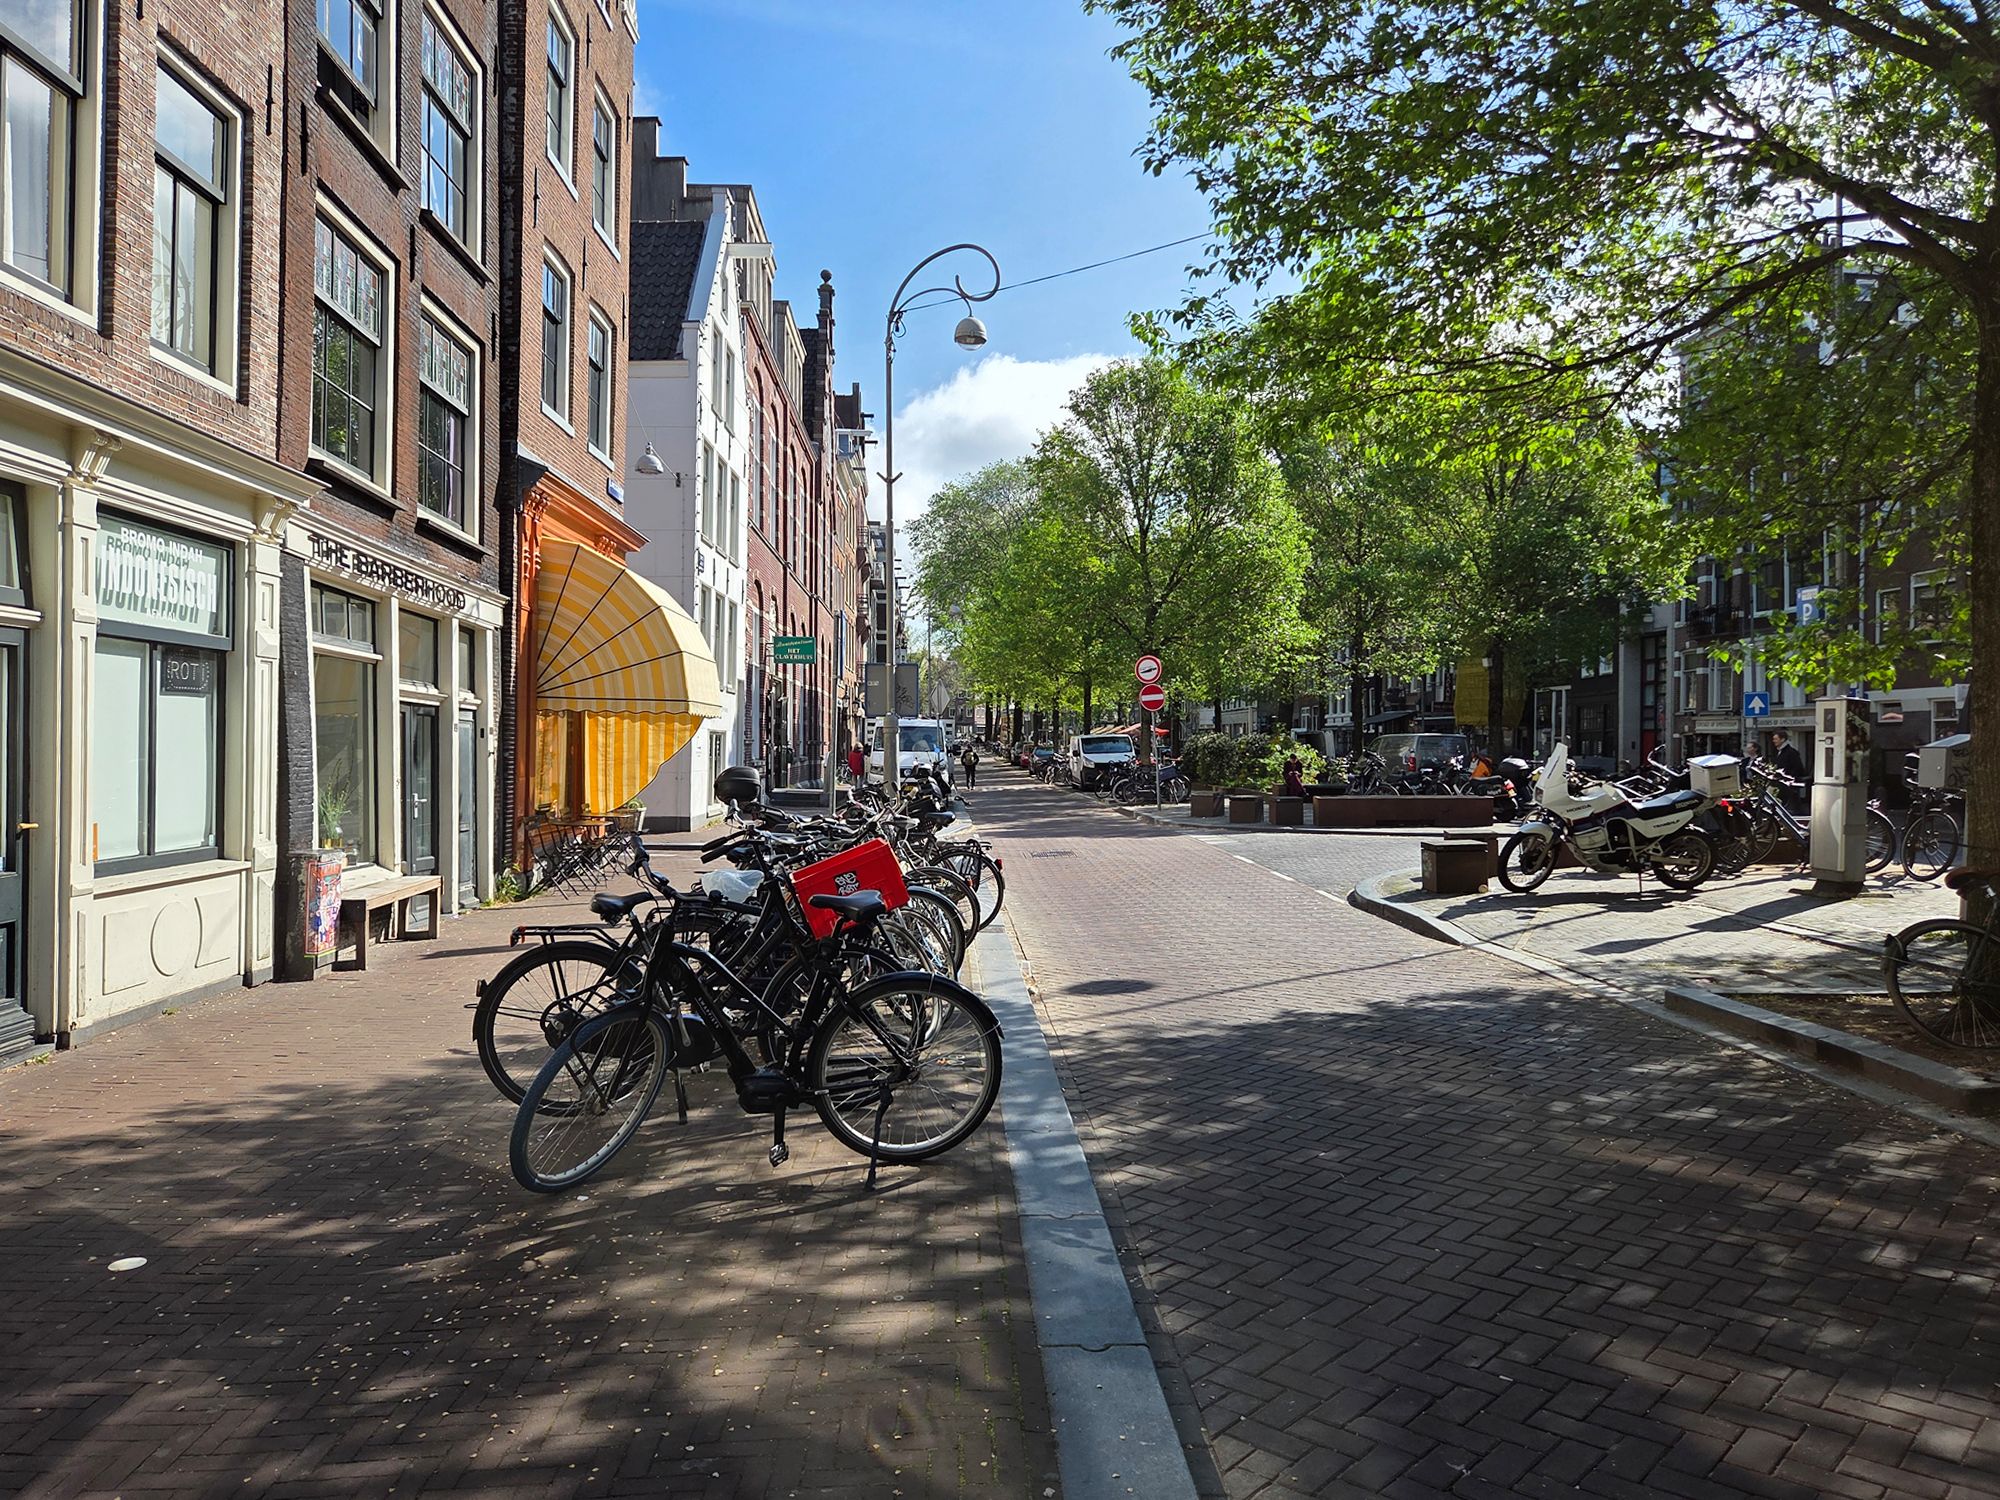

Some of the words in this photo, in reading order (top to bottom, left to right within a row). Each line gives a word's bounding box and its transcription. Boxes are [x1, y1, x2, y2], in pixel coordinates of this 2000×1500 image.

[120, 527, 166, 554] BROMO
[168, 540, 203, 563] INDAH
[308, 531, 351, 569] THE
[352, 553, 466, 610] BARBERHOOD
[101, 545, 218, 613] INDONESISCH
[1566, 803, 1592, 813] HONDA
